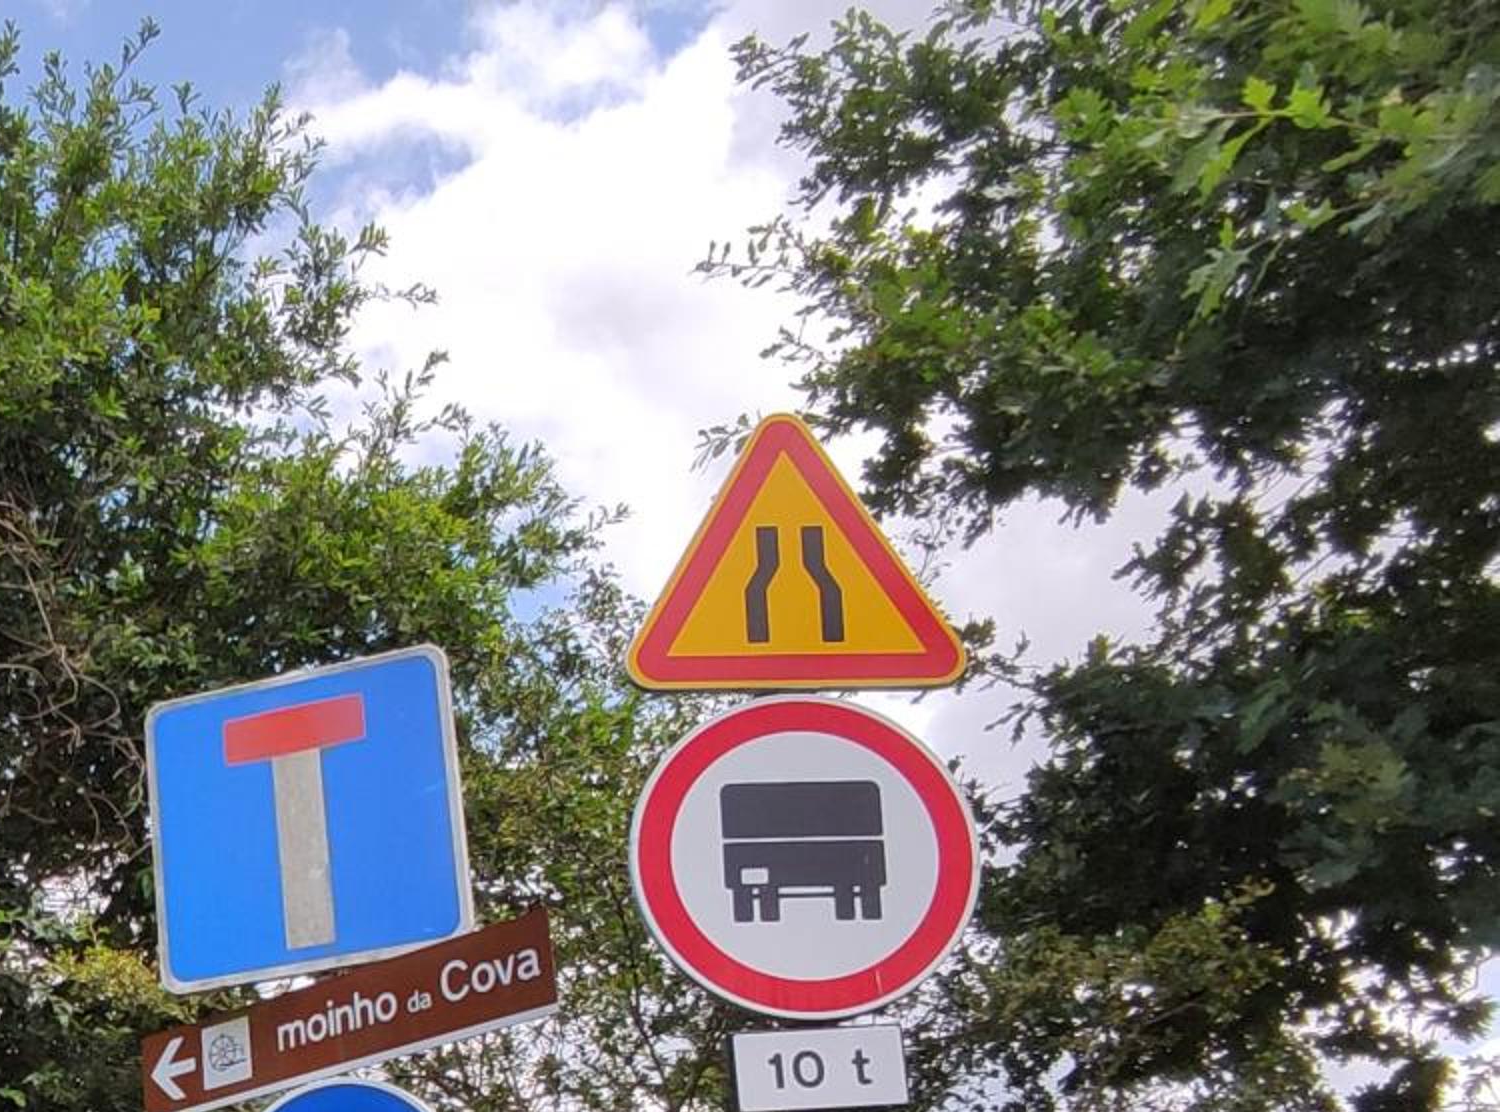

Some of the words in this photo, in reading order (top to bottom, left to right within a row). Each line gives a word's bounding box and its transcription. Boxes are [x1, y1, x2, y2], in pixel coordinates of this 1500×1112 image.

[277, 992, 396, 1052] moinho
[407, 990, 432, 1013] da
[440, 948, 541, 1001] Cova
[768, 1050, 825, 1089] 10
[851, 1049, 872, 1085] t
